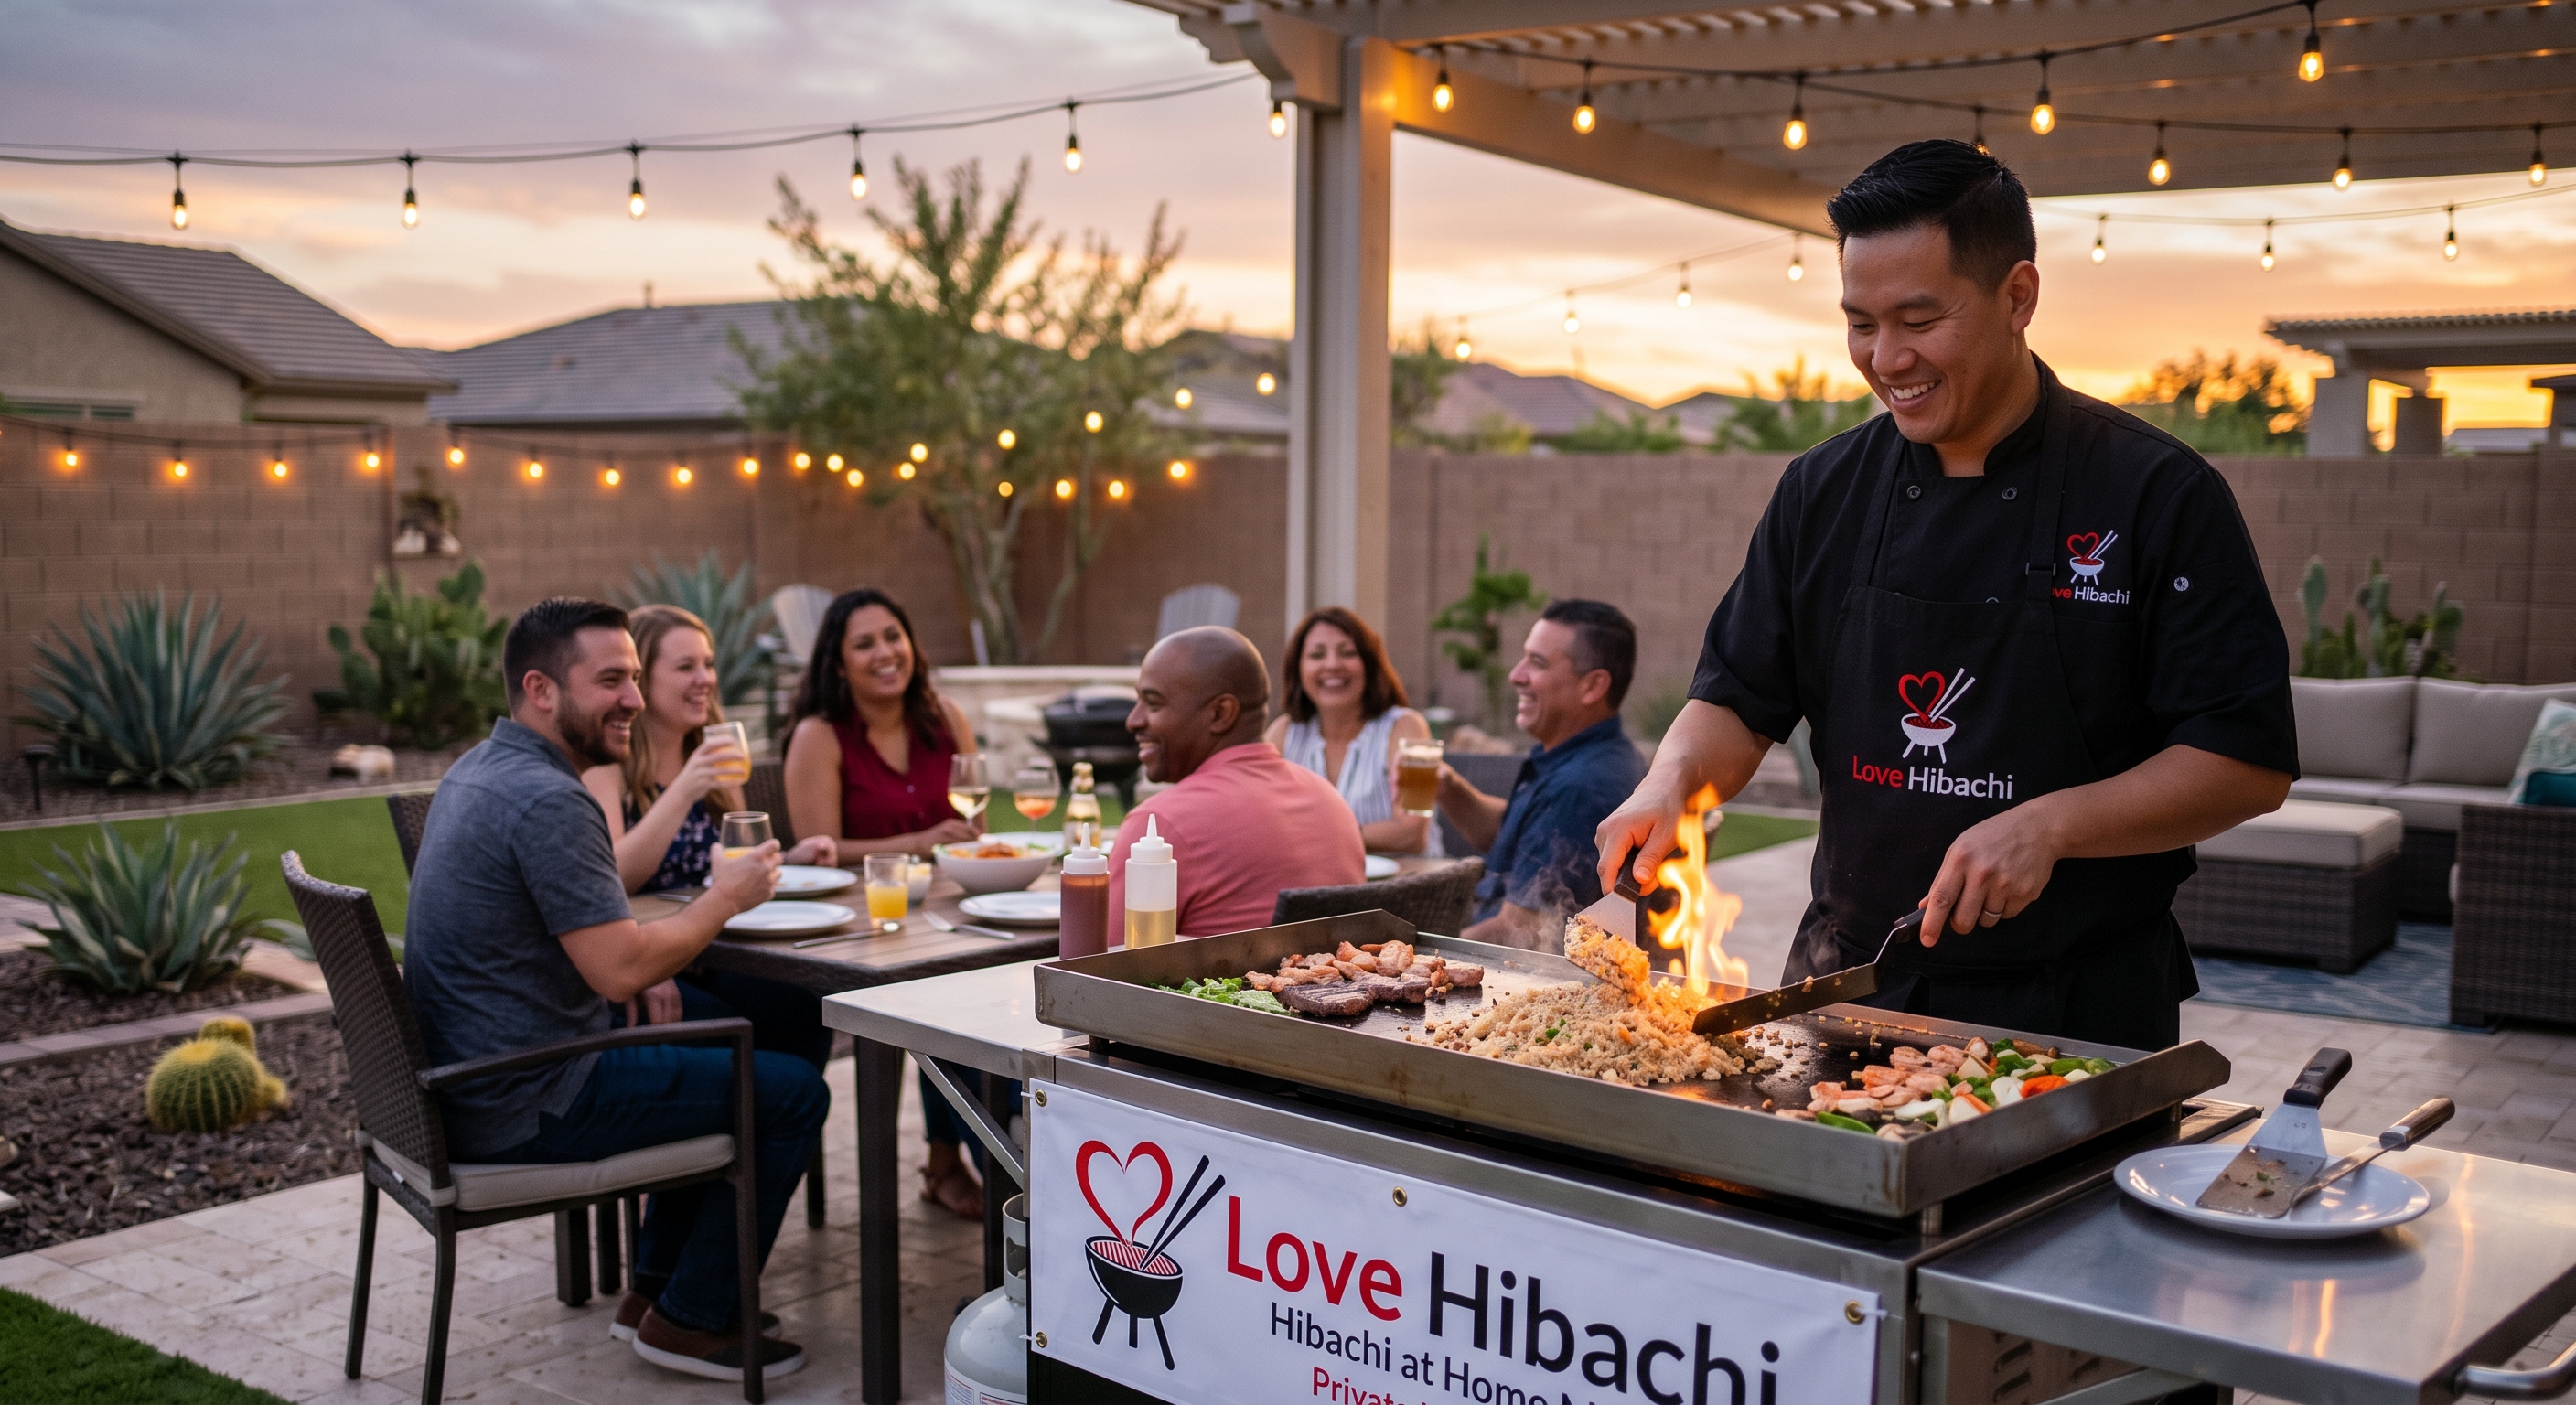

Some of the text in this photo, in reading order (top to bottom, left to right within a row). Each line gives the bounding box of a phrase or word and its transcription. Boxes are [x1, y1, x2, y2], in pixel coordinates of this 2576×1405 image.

[2052, 586, 2131, 605] ve Hibachi
[1852, 755, 2012, 799] Love Hibachi
[1227, 1195, 1780, 1405] Love Hibachi
[1271, 1301, 1391, 1372] Hibachi
[1401, 1352, 1434, 1386] at
